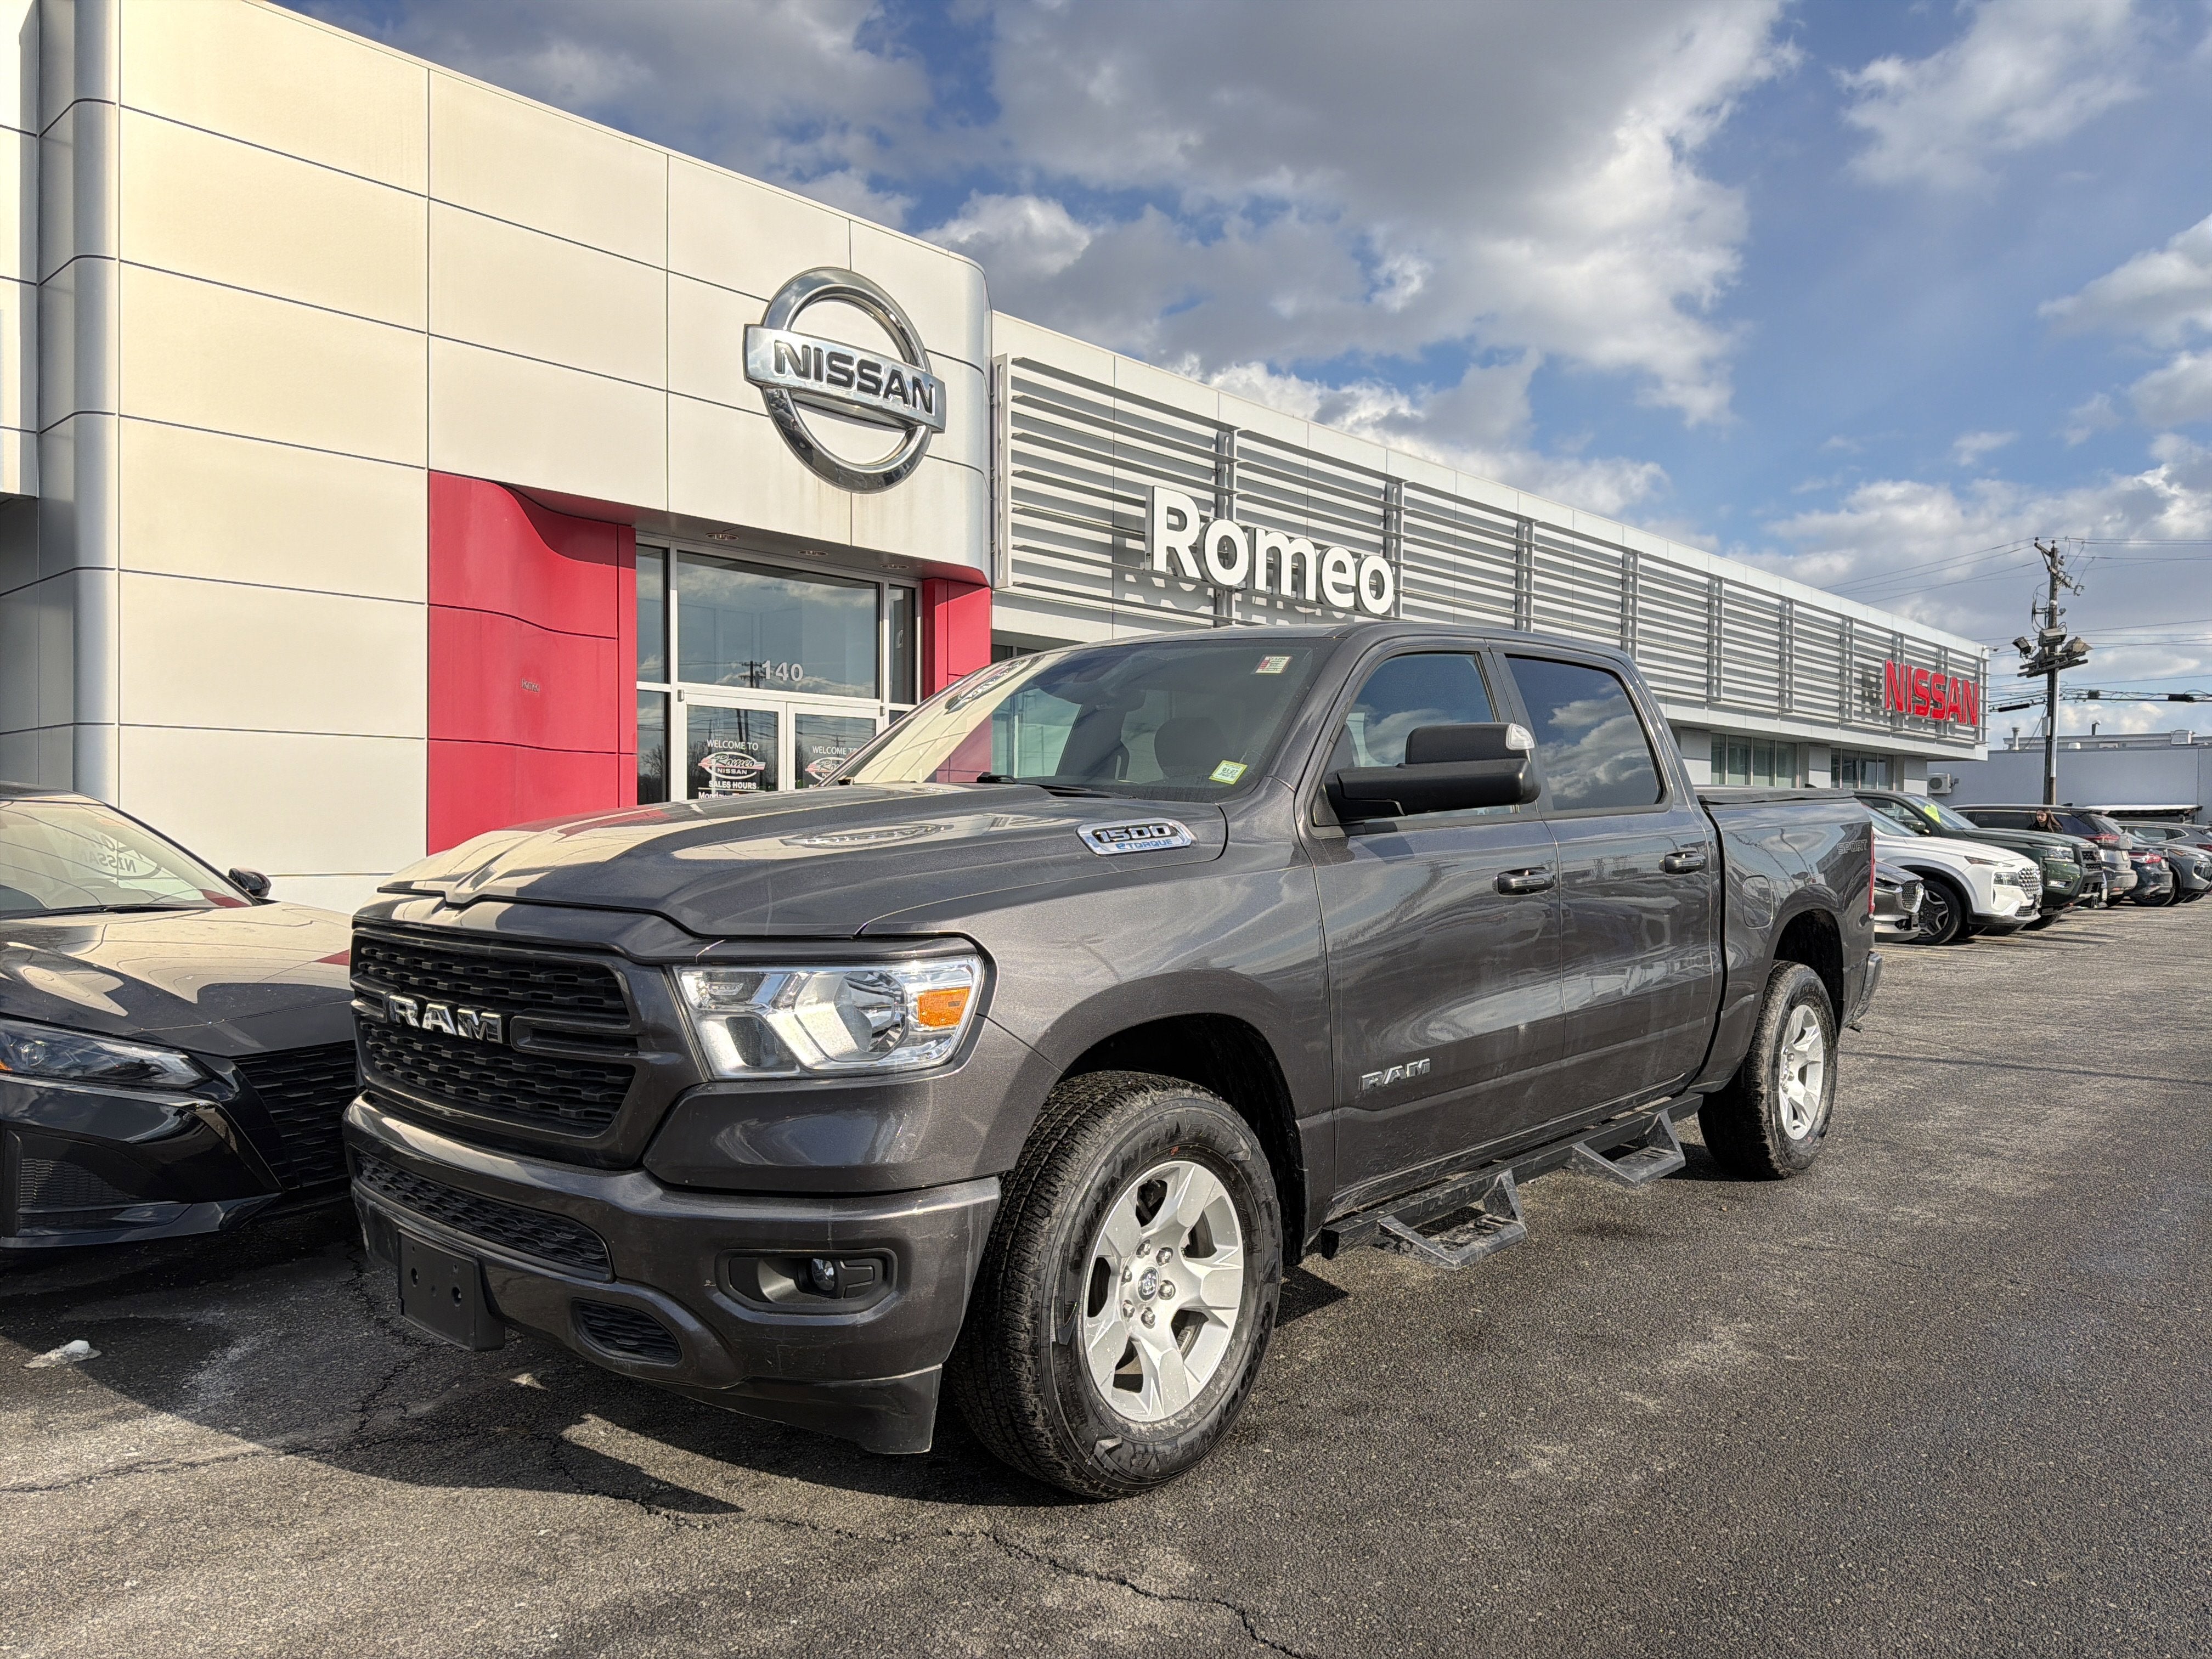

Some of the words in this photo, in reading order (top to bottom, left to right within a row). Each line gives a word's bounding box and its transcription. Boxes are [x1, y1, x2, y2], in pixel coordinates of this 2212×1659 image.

[774, 340, 935, 415] NISSAN
[1146, 485, 1394, 614] Romeo
[762, 661, 803, 681] 140
[1883, 659, 1978, 726] NISSAN
[707, 739, 746, 750] WELCOME
[747, 742, 759, 751] TO
[812, 746, 847, 755] WELCOME
[711, 753, 755, 768] Romeo
[708, 780, 731, 788] SALES
[732, 781, 757, 789] HOURS
[1096, 825, 1171, 843] 1500
[1837, 839, 1868, 855] SPORT
[388, 994, 504, 1044] RAM
[1359, 1058, 1430, 1092] RAM
